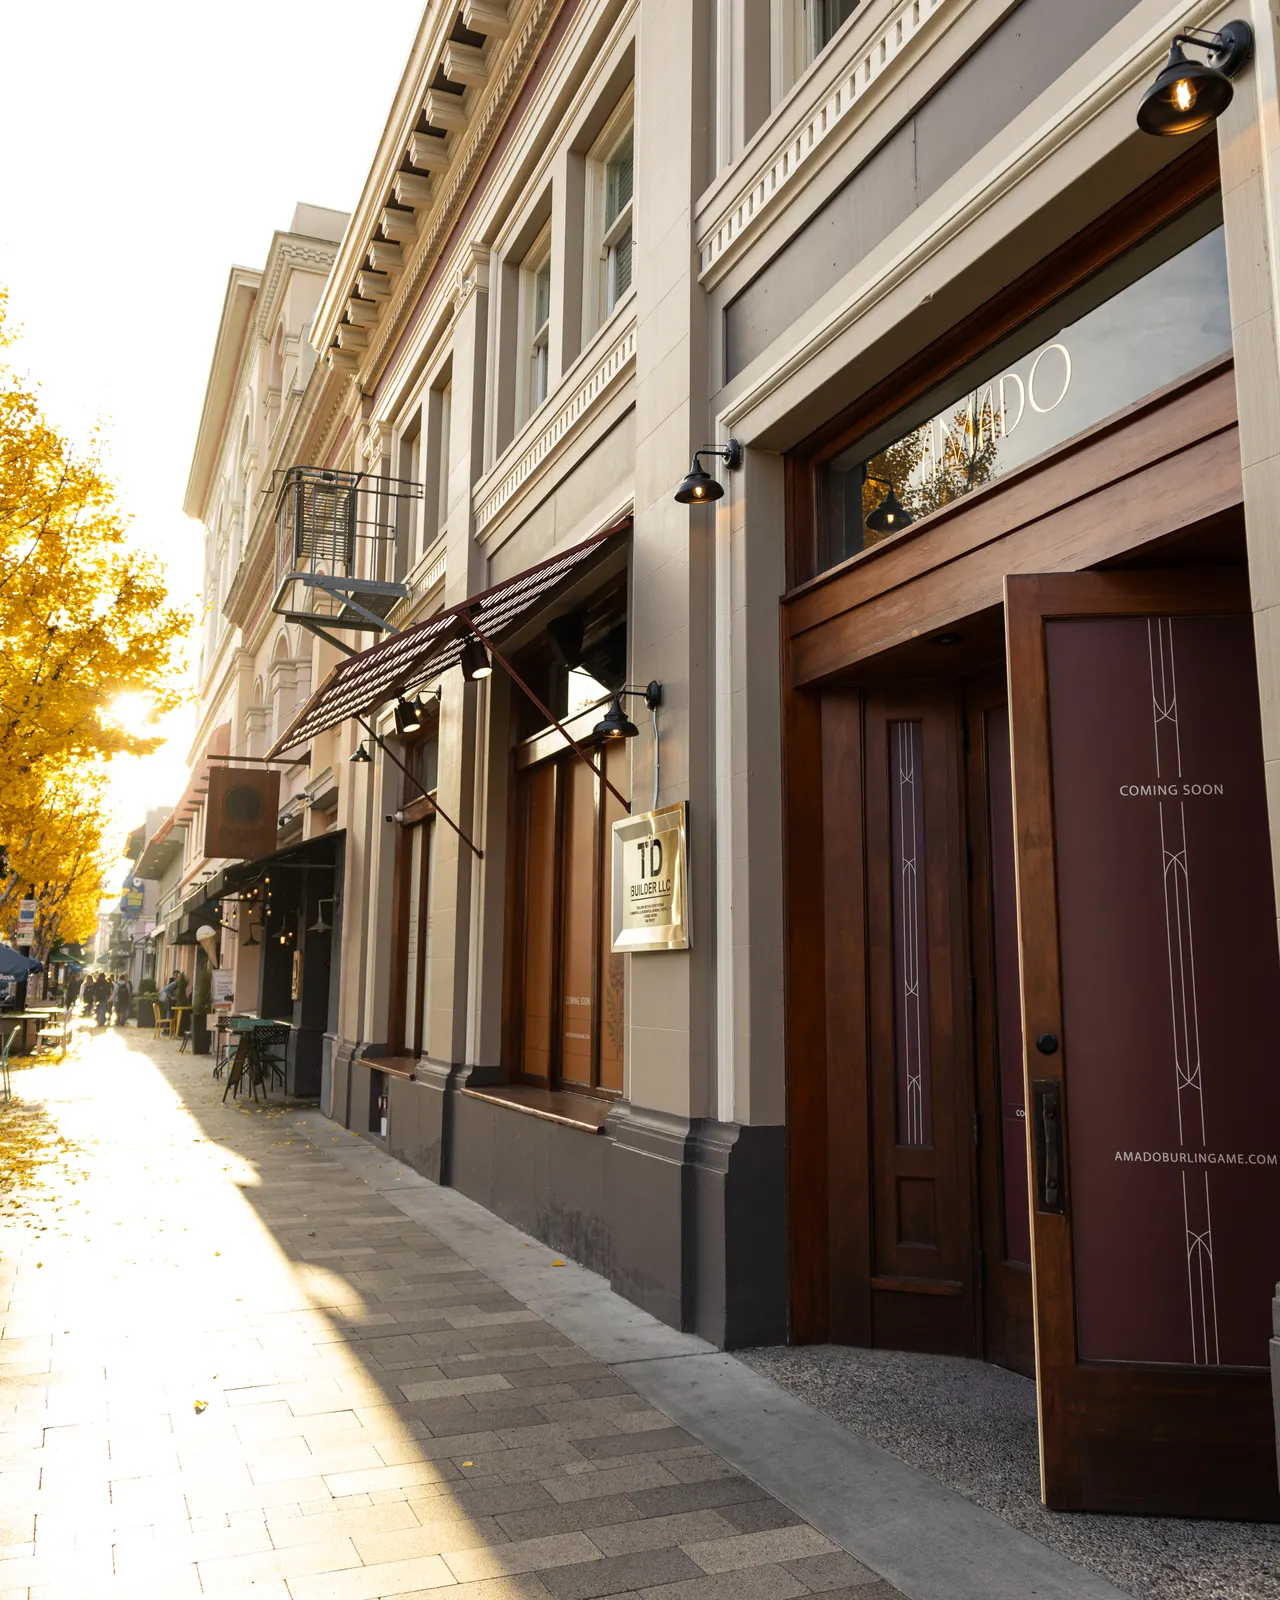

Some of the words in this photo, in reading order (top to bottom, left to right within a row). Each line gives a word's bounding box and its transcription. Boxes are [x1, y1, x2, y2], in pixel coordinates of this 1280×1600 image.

[921, 343, 1072, 486] AMADO
[1119, 785, 1178, 797] COMING
[1182, 784, 1224, 796] SOON
[631, 881, 657, 896] BUILDER
[658, 879, 671, 892] LLC
[1114, 1151, 1278, 1165] AMADOBURLINGAME.COM
